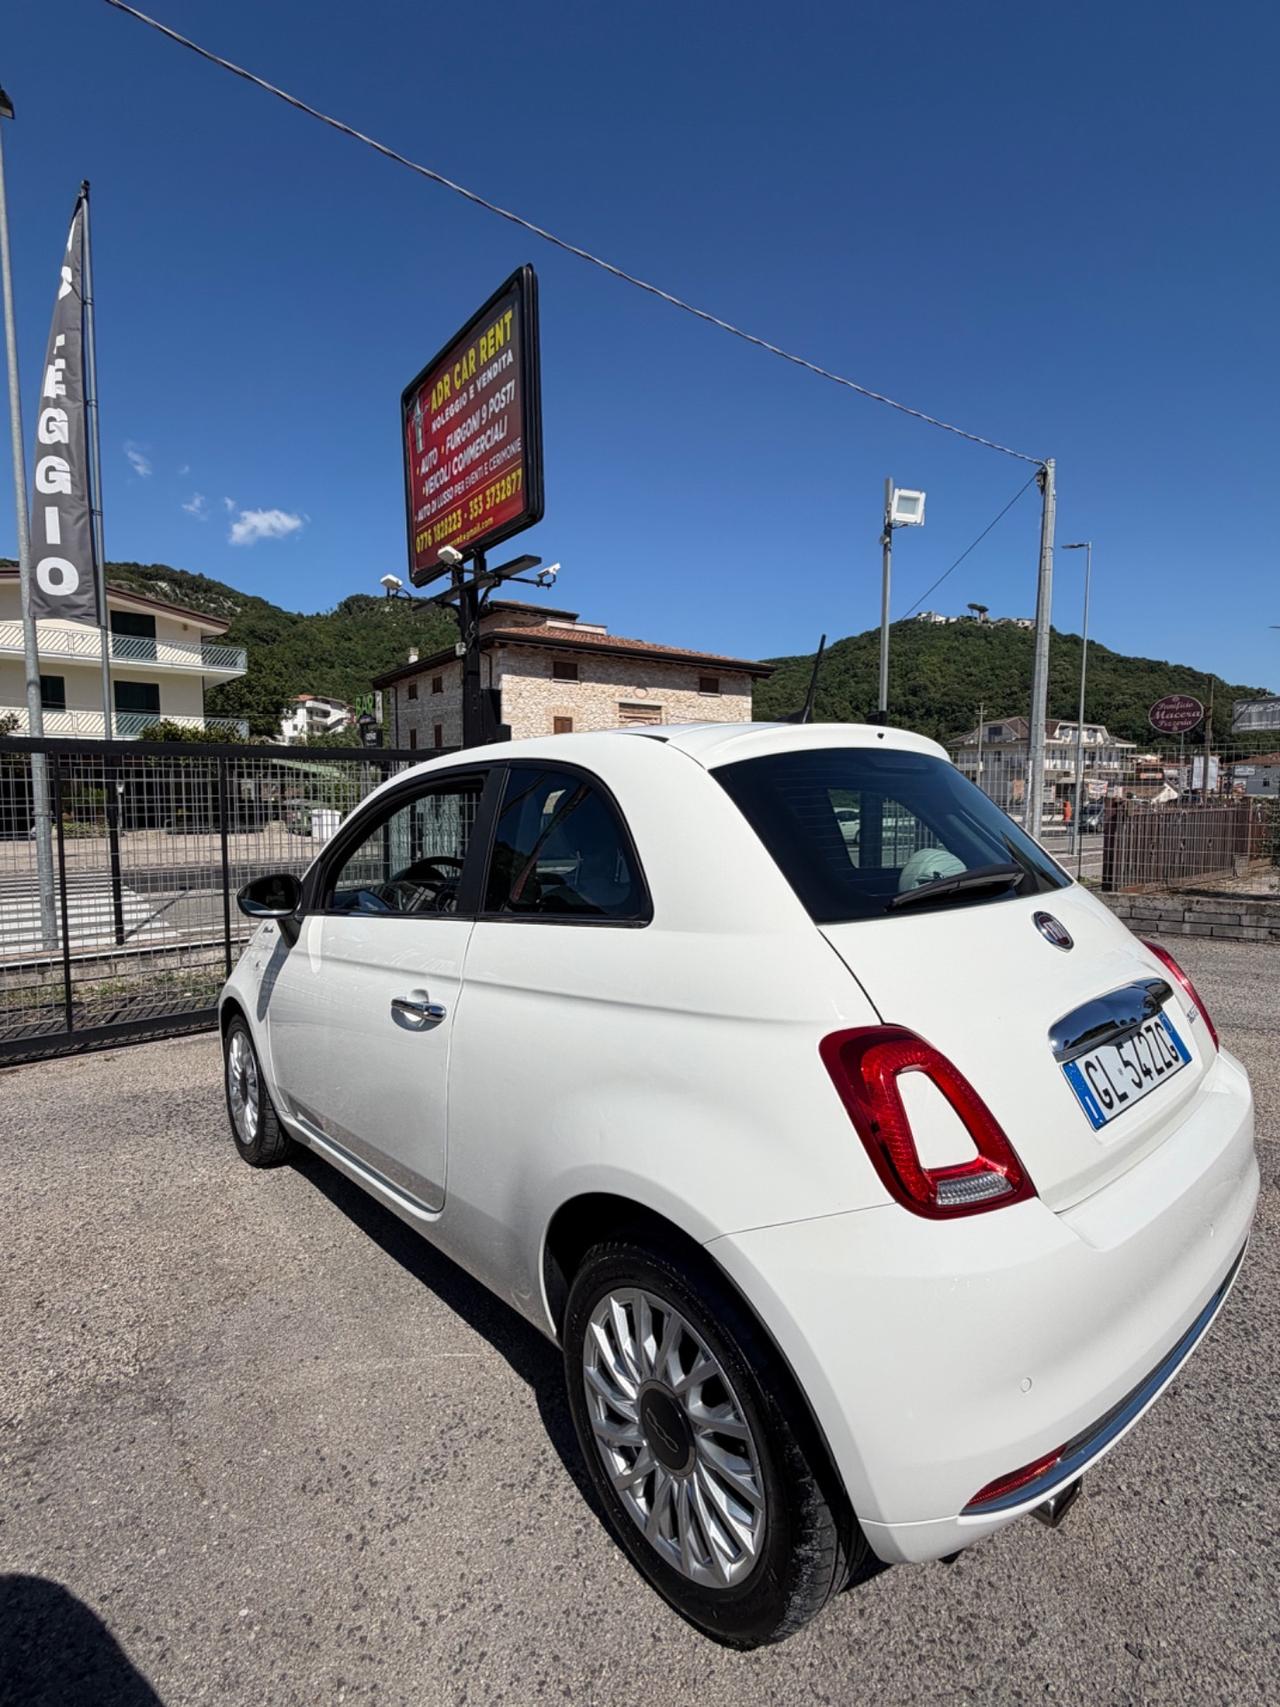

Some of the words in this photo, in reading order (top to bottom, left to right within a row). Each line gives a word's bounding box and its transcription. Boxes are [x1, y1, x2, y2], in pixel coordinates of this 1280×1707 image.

[36, 217, 80, 596] EGGIO
[431, 373, 451, 414] ADR
[454, 347, 476, 390] CAR
[480, 309, 512, 366] RENT
[432, 392, 467, 433] NOLEGGIO
[469, 384, 475, 400] E
[476, 349, 514, 392] VENDITA
[420, 447, 438, 476] AUTO
[446, 408, 480, 455] FURGONI
[481, 404, 487, 425] 9
[488, 378, 515, 419] POSTI
[425, 461, 451, 497] VEICOLI
[452, 415, 508, 476] COMMERCIALI
[1084, 1055, 1129, 1110] GL
[1116, 1021, 1180, 1089] 542ZG
